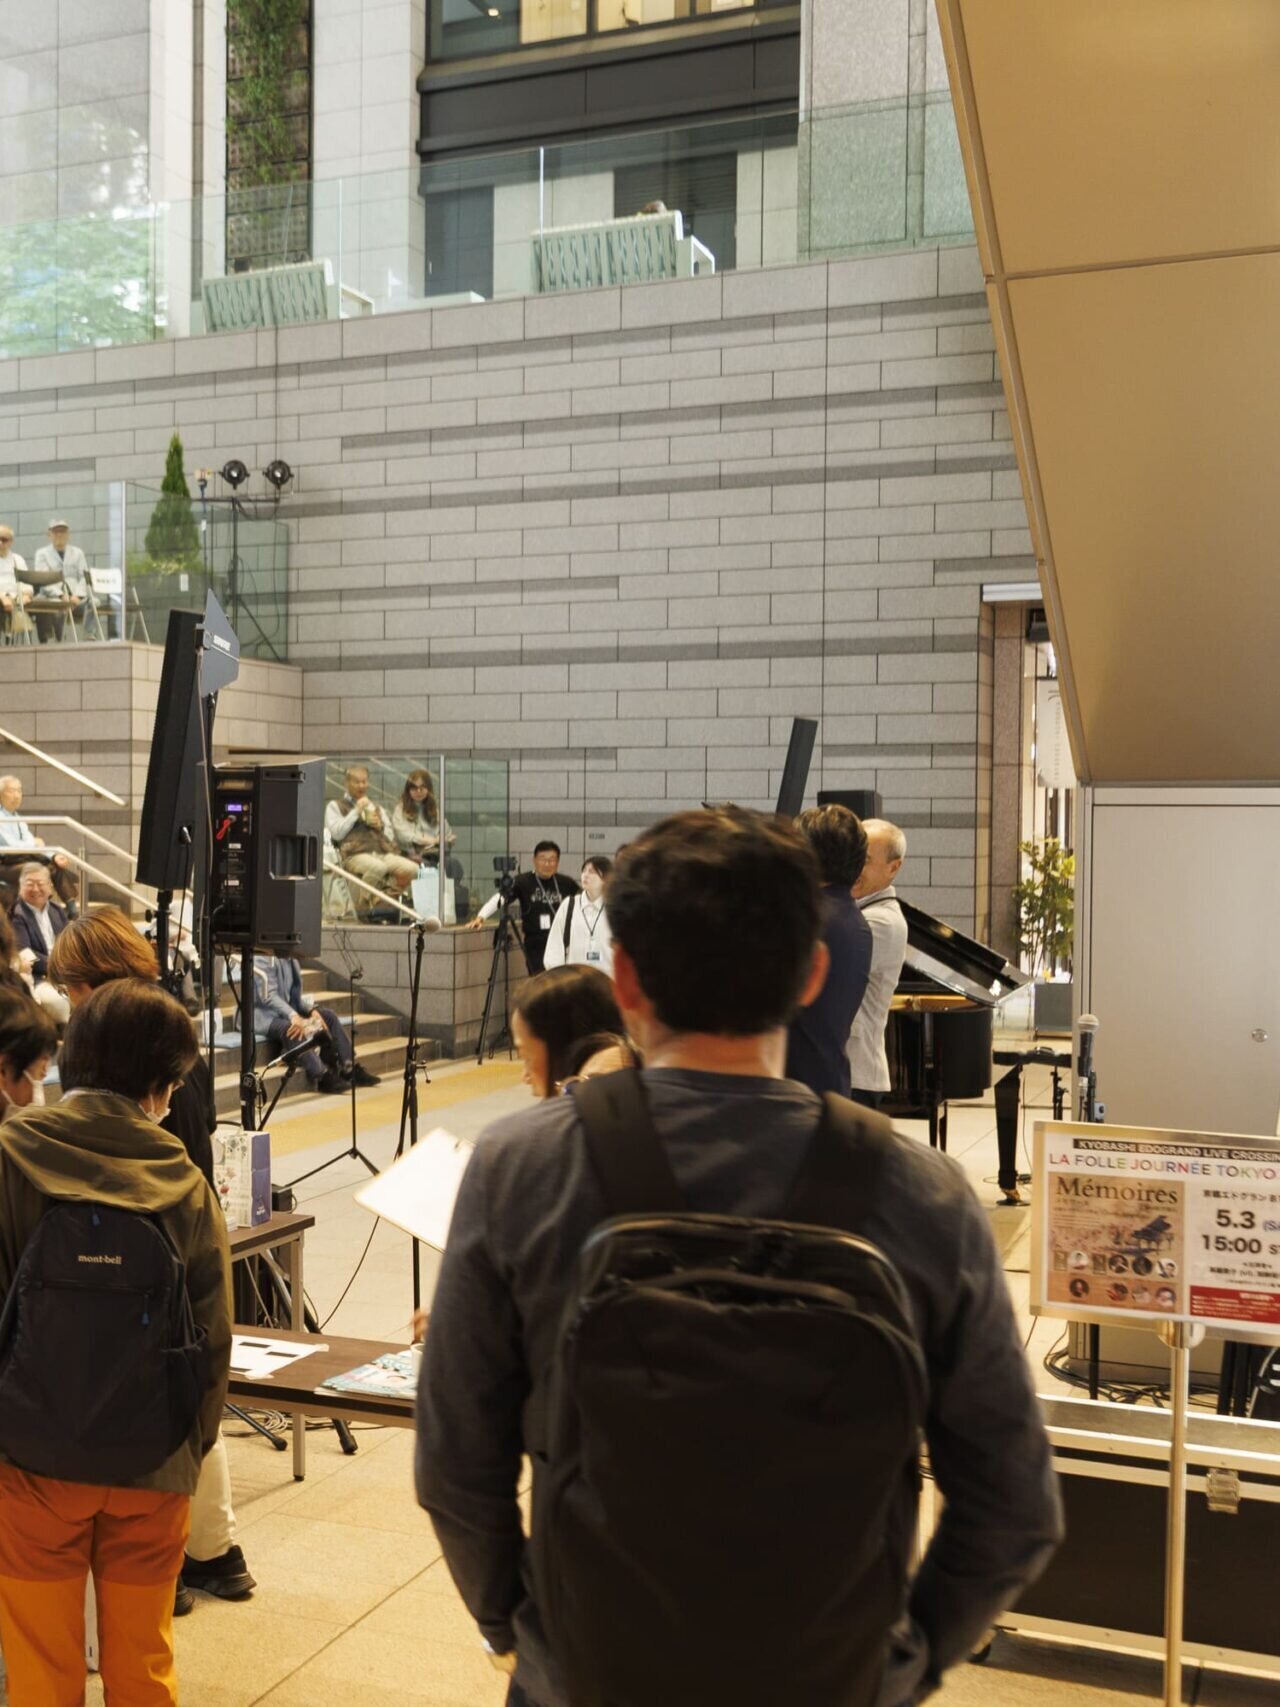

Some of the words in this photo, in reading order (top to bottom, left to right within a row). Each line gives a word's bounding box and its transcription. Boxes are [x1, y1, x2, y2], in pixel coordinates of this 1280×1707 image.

[1078, 1140, 1136, 1153] KYOBASHI
[1137, 1144, 1201, 1158] EDOGRAND
[1203, 1147, 1229, 1159] LIVE
[1049, 1153, 1070, 1166] LA
[1074, 1154, 1128, 1169] FOLLE
[1129, 1159, 1211, 1176] JOURNÉE
[1215, 1164, 1276, 1180] TOKYO
[1055, 1175, 1179, 1205] Mémoires
[1216, 1208, 1256, 1230] 5.3
[1201, 1233, 1262, 1254] 15:00
